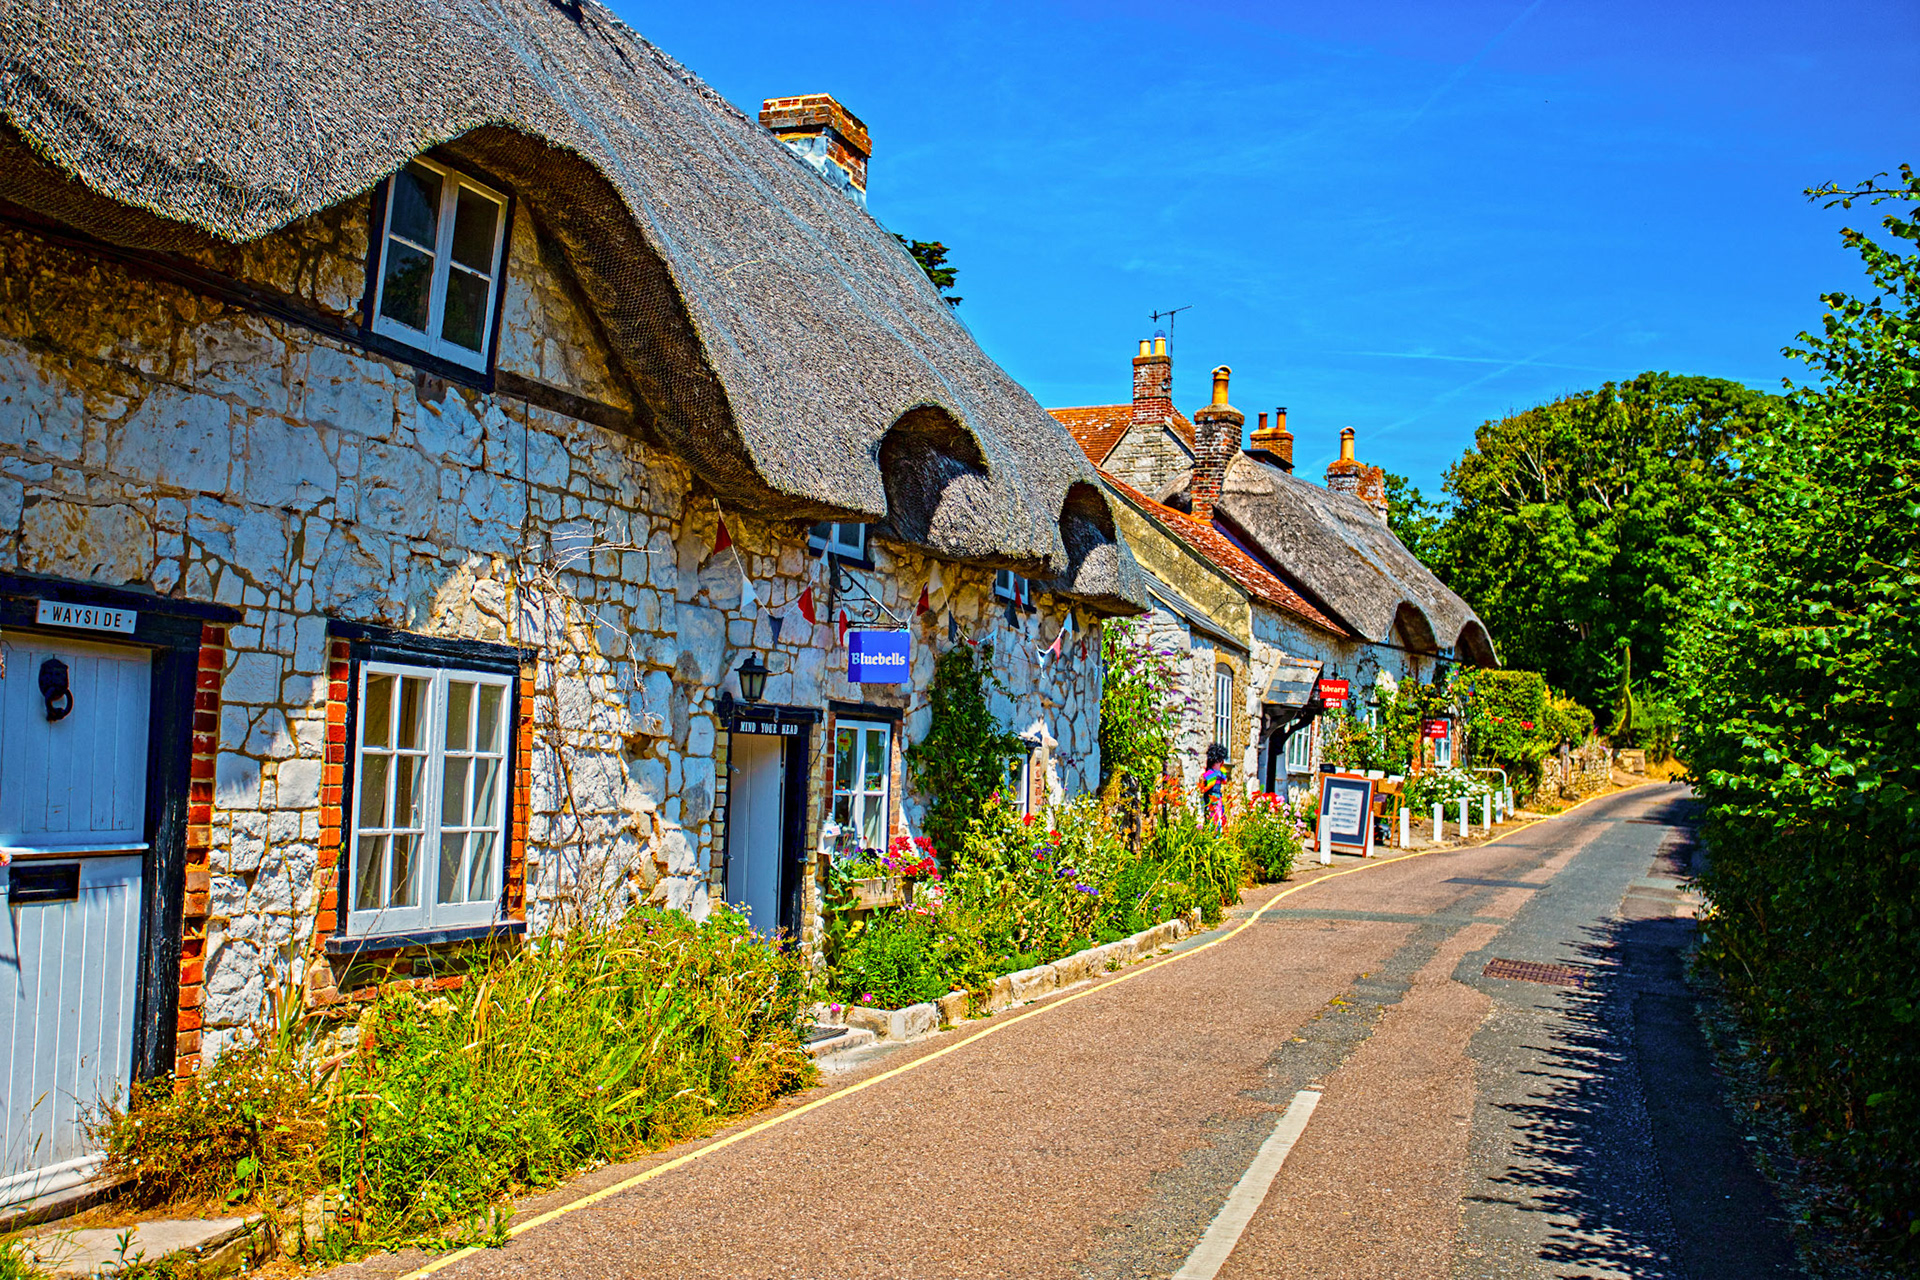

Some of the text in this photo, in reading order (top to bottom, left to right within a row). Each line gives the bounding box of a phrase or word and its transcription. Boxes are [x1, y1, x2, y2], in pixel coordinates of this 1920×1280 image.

[53, 606, 121, 627] WAYSIDE
[851, 652, 906, 665] Bluebells
[1321, 684, 1346, 696] Library
[740, 721, 798, 735] MIND YOUR HEAD
